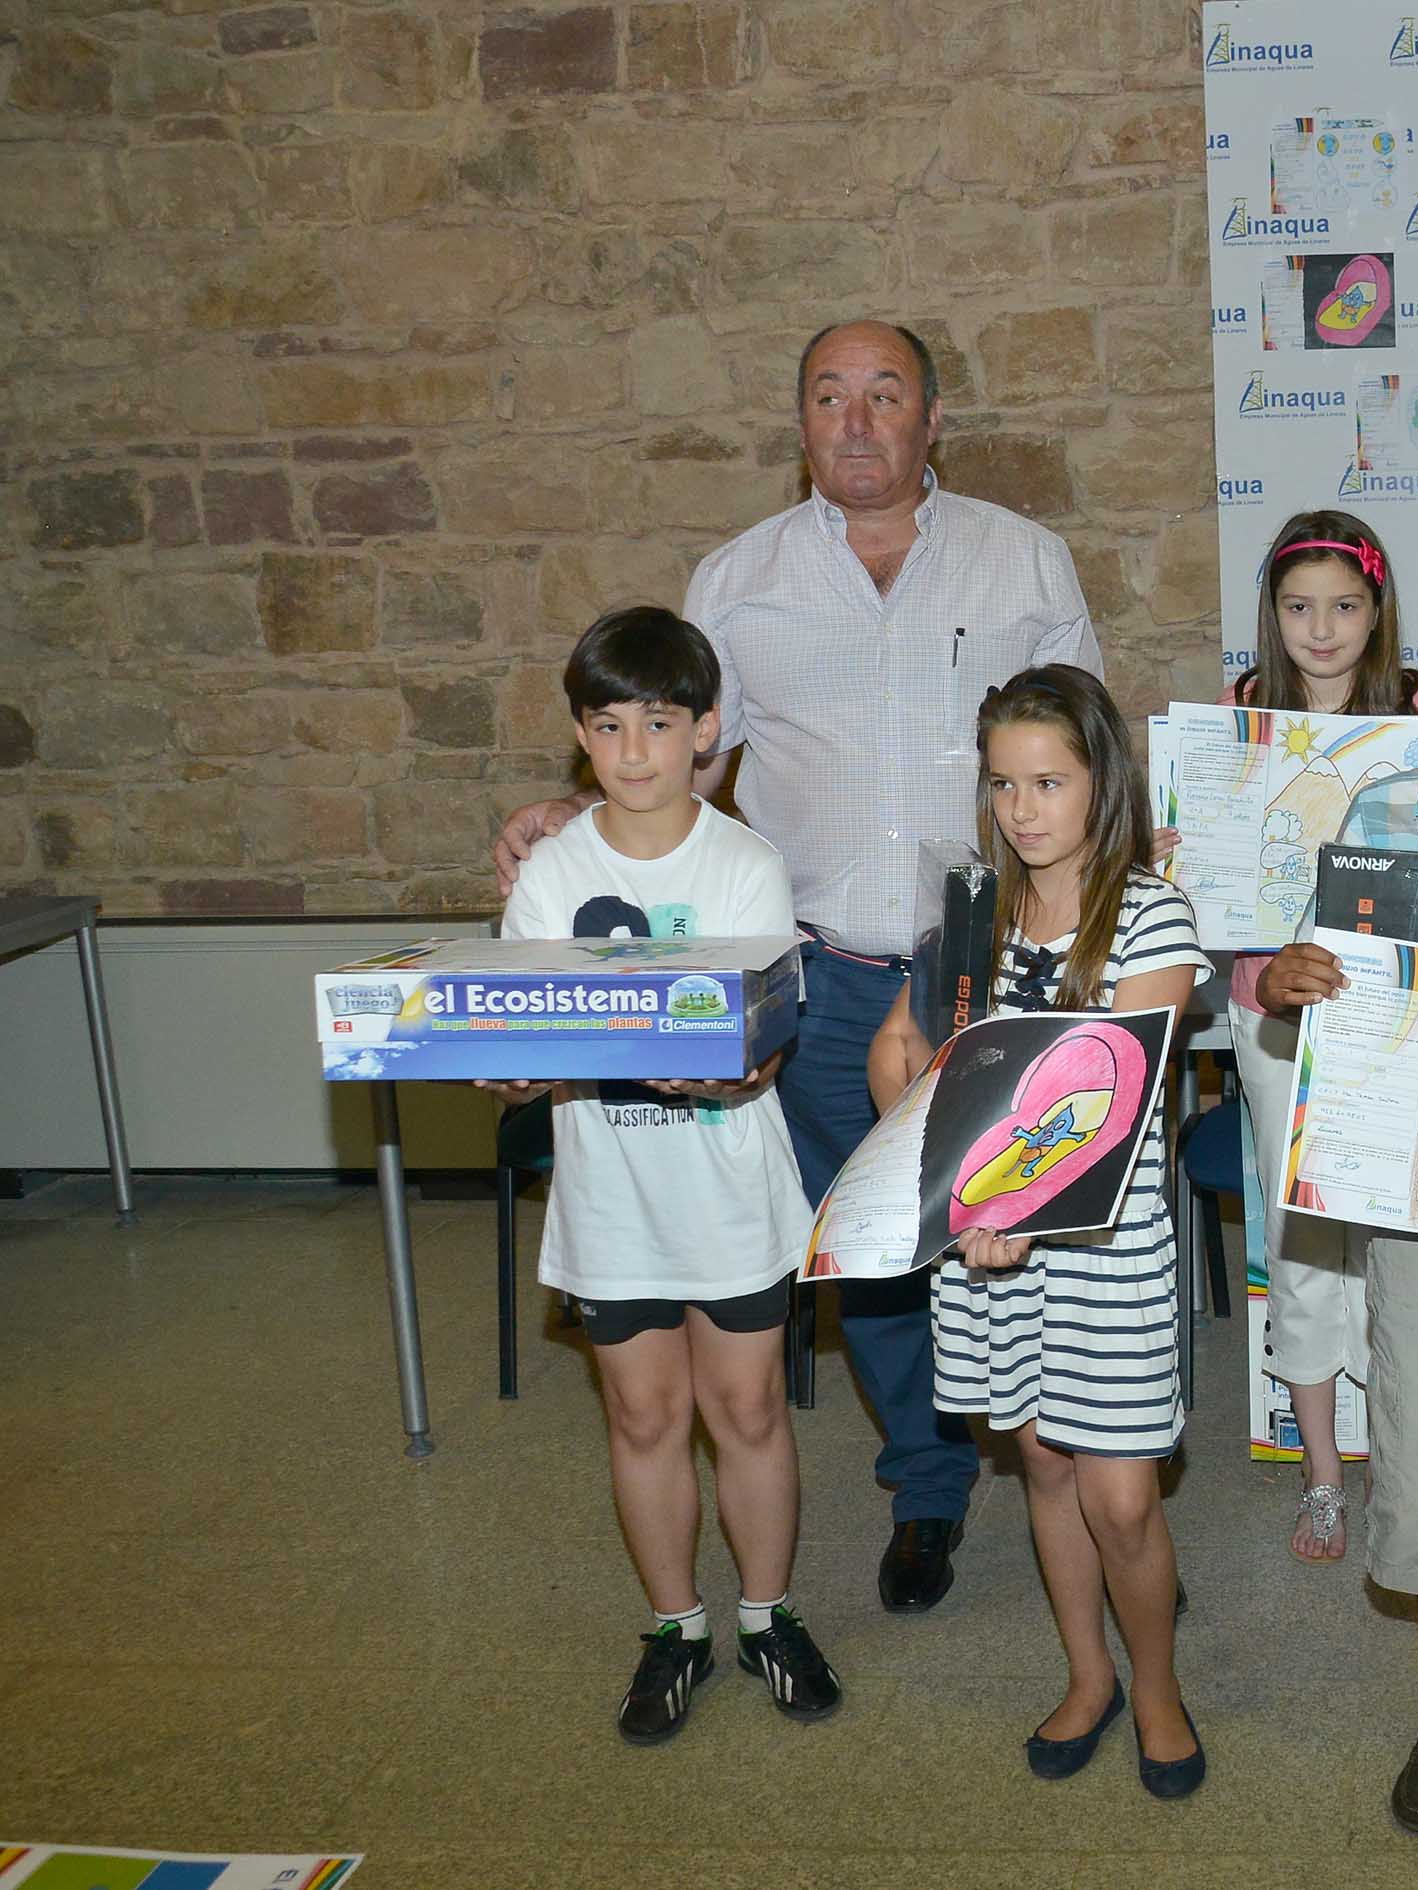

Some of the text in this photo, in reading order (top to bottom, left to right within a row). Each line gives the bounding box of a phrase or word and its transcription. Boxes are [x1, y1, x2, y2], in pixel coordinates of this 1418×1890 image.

[1331, 855, 1396, 872] ARNOVA
[424, 982, 658, 1014] el Ecosistema
[607, 1015, 653, 1031] plantas
[673, 1019, 735, 1031] Clementoni
